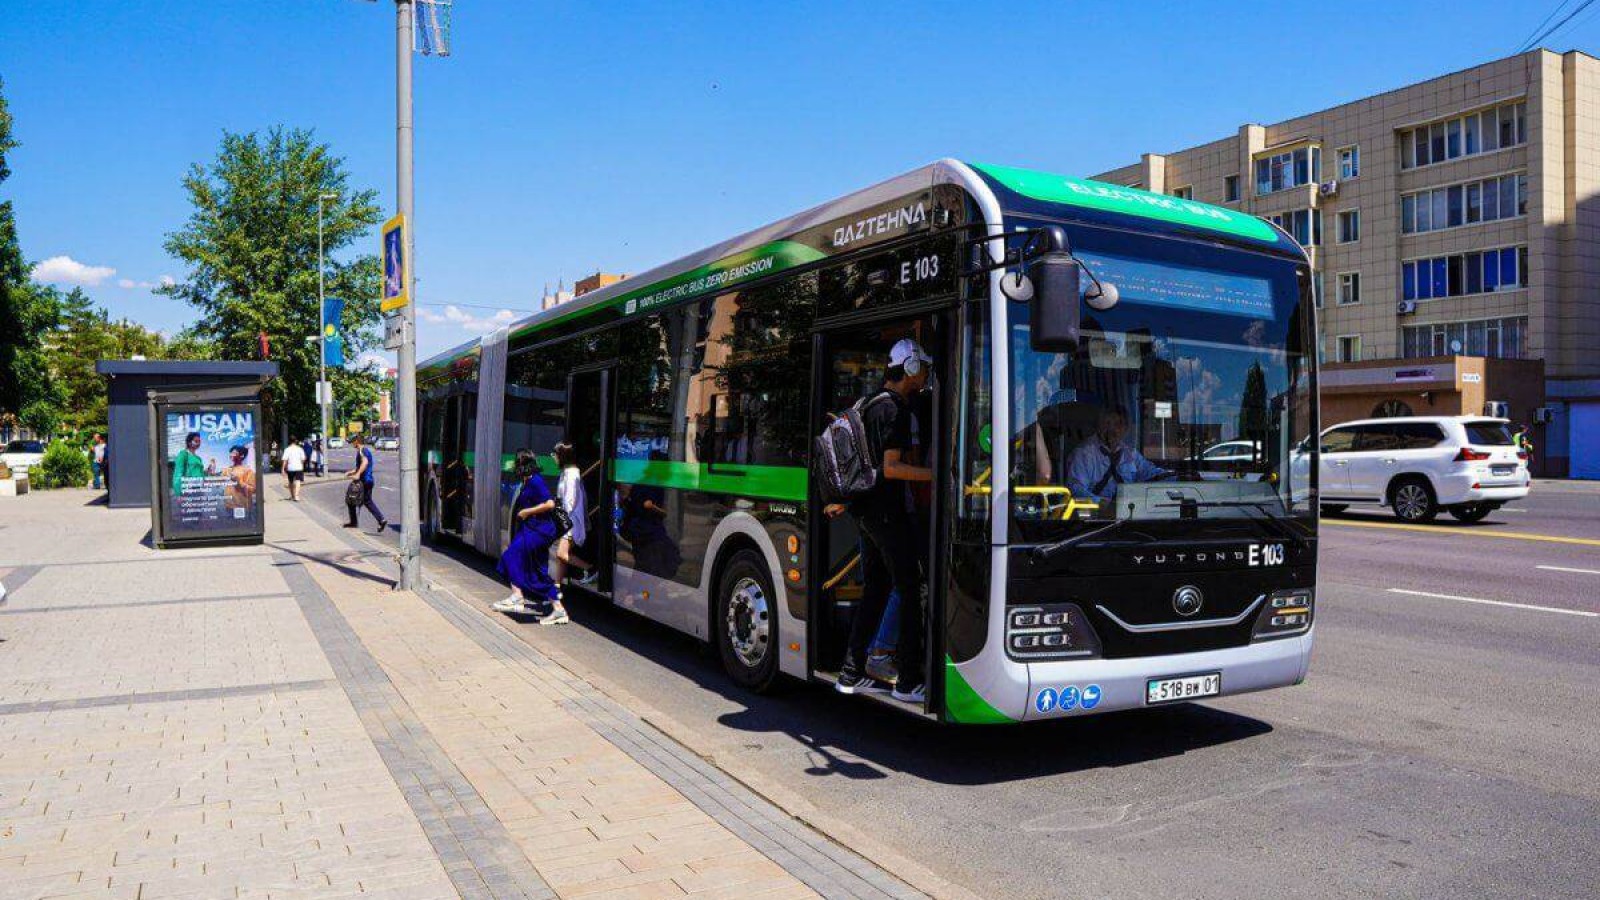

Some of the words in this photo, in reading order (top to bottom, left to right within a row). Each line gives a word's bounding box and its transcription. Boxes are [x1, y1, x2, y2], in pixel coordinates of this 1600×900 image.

[1064, 181, 1184, 211] ELECTRIC
[1183, 202, 1233, 221] BUS
[833, 202, 926, 246] QAZTEHNA
[656, 282, 689, 303] ELECTRIC
[689, 277, 704, 293] BUS
[705, 271, 728, 288] ZERO
[728, 256, 774, 280] EMISSION
[901, 262, 910, 284] E
[915, 255, 939, 281] 103
[171, 412, 252, 433] JUSAN
[1133, 551, 1244, 564] YUTONG
[1248, 544, 1260, 566] E
[1262, 543, 1285, 566] 103
[1160, 681, 1183, 699] 518
[1204, 675, 1218, 693] 01
